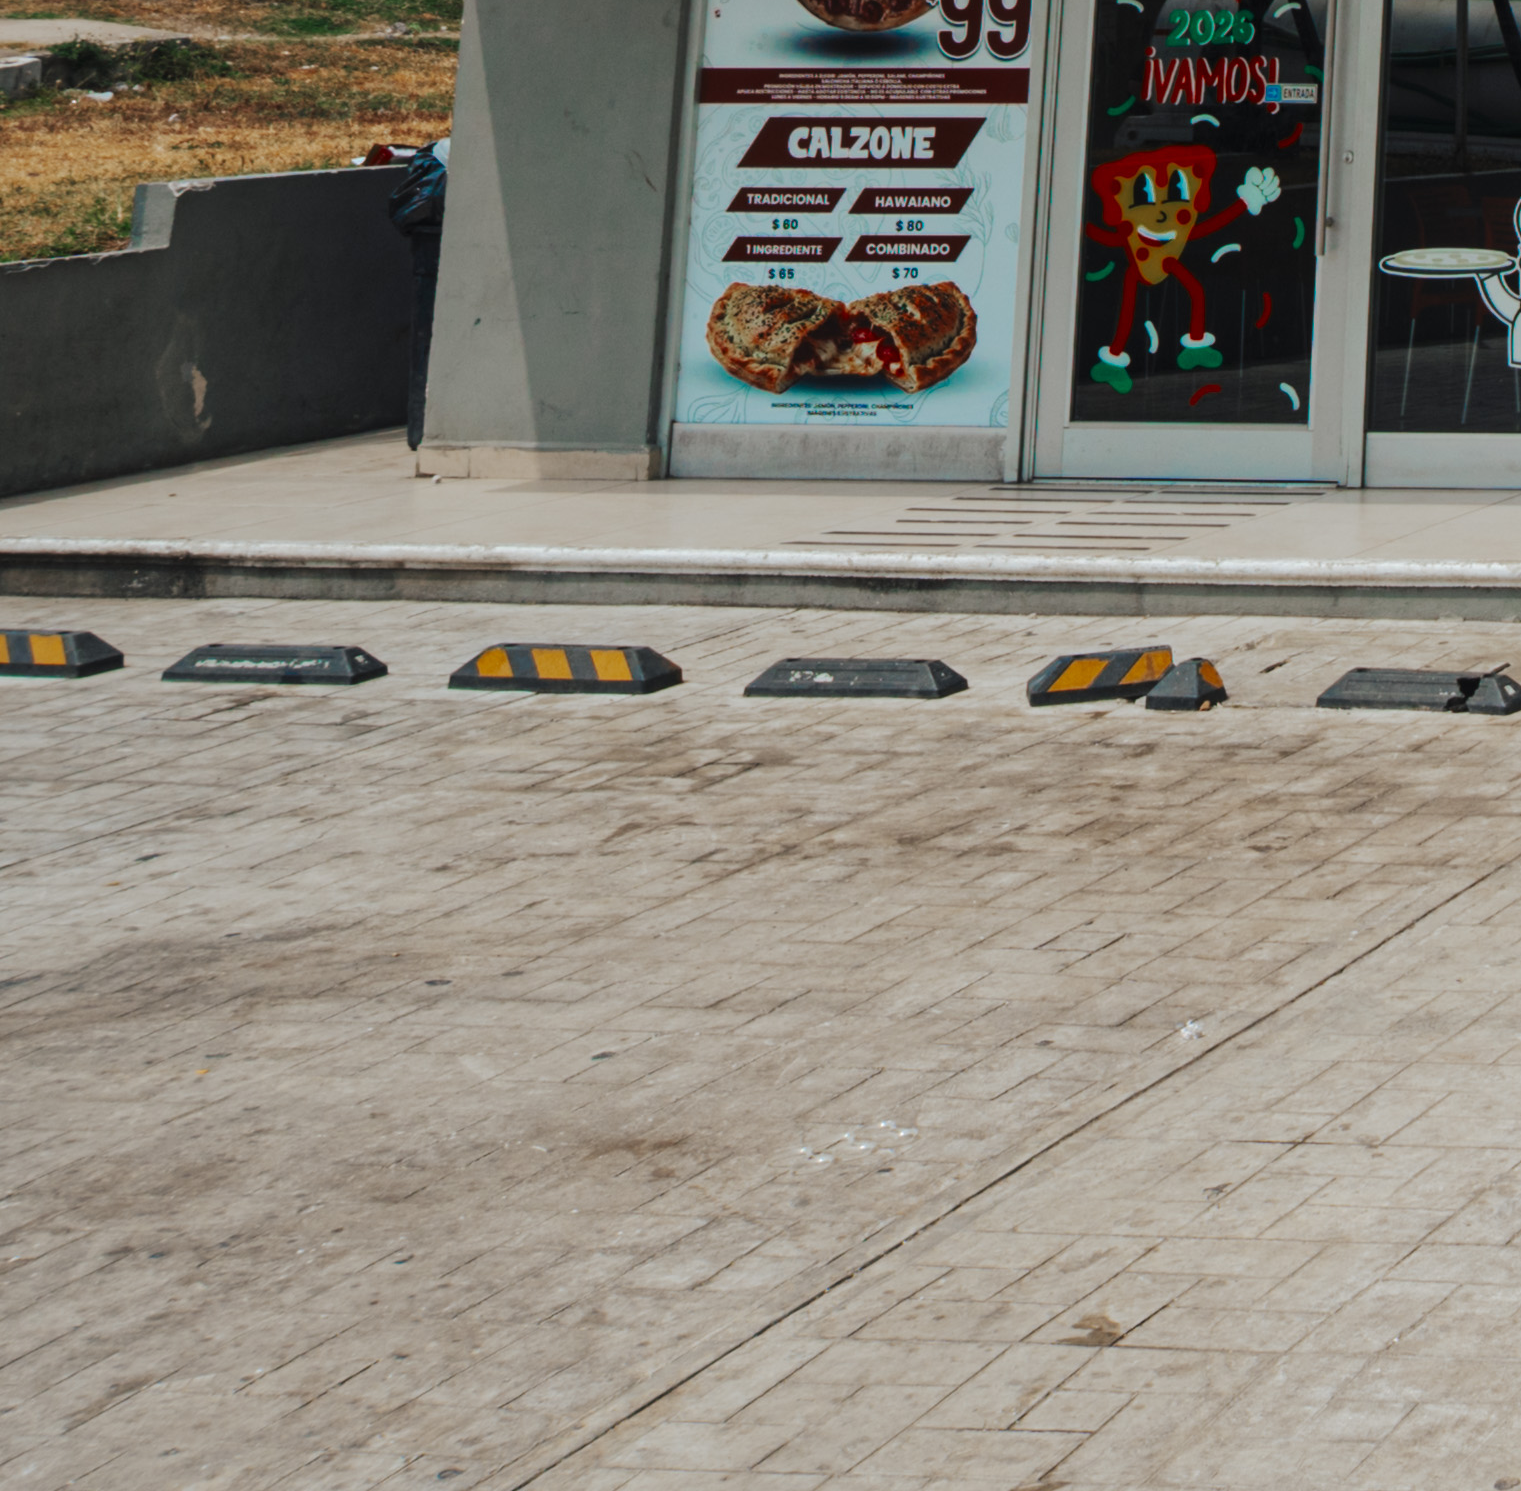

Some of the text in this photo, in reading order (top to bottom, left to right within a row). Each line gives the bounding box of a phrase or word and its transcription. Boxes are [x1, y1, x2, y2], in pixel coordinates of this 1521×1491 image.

[1165, 9, 1256, 46] 2026
[1282, 86, 1316, 99] ENTRADA
[787, 125, 936, 160] CALZONE
[746, 193, 830, 207] TRADICIONAL
[874, 195, 951, 209] HAWAIANO
[752, 244, 823, 256] INGREDIENTE
[865, 242, 951, 256] COMBINADO
